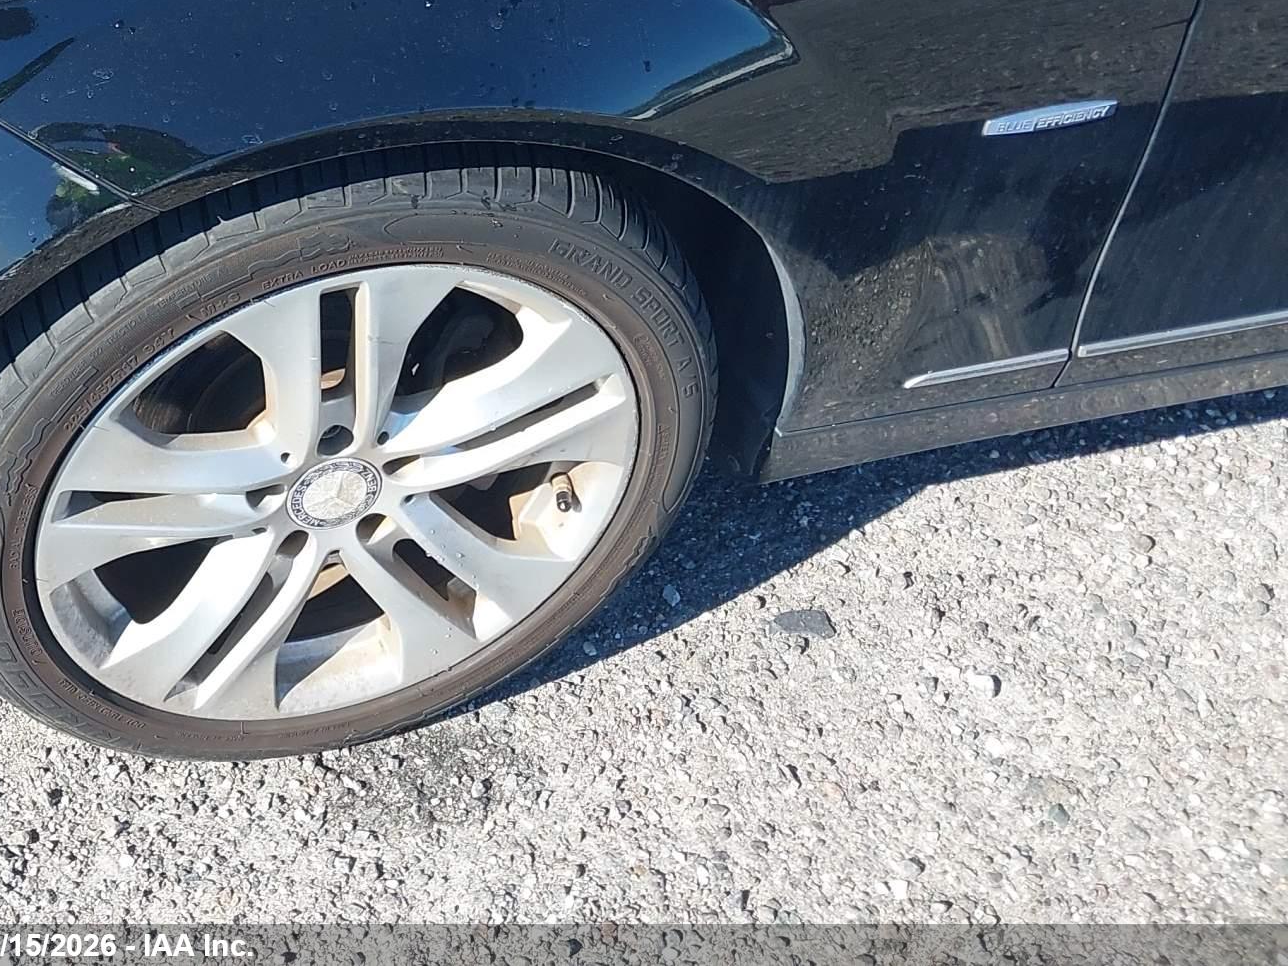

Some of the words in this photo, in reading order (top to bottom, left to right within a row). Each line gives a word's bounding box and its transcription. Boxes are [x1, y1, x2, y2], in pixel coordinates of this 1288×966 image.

[261, 269, 304, 291] EXTRA
[310, 259, 347, 275] LOAD
[199, 292, 241, 317] M+S
[630, 287, 685, 347] SPORT
[359, 467, 378, 493] BENZ
[291, 485, 320, 527] MERCEDES
